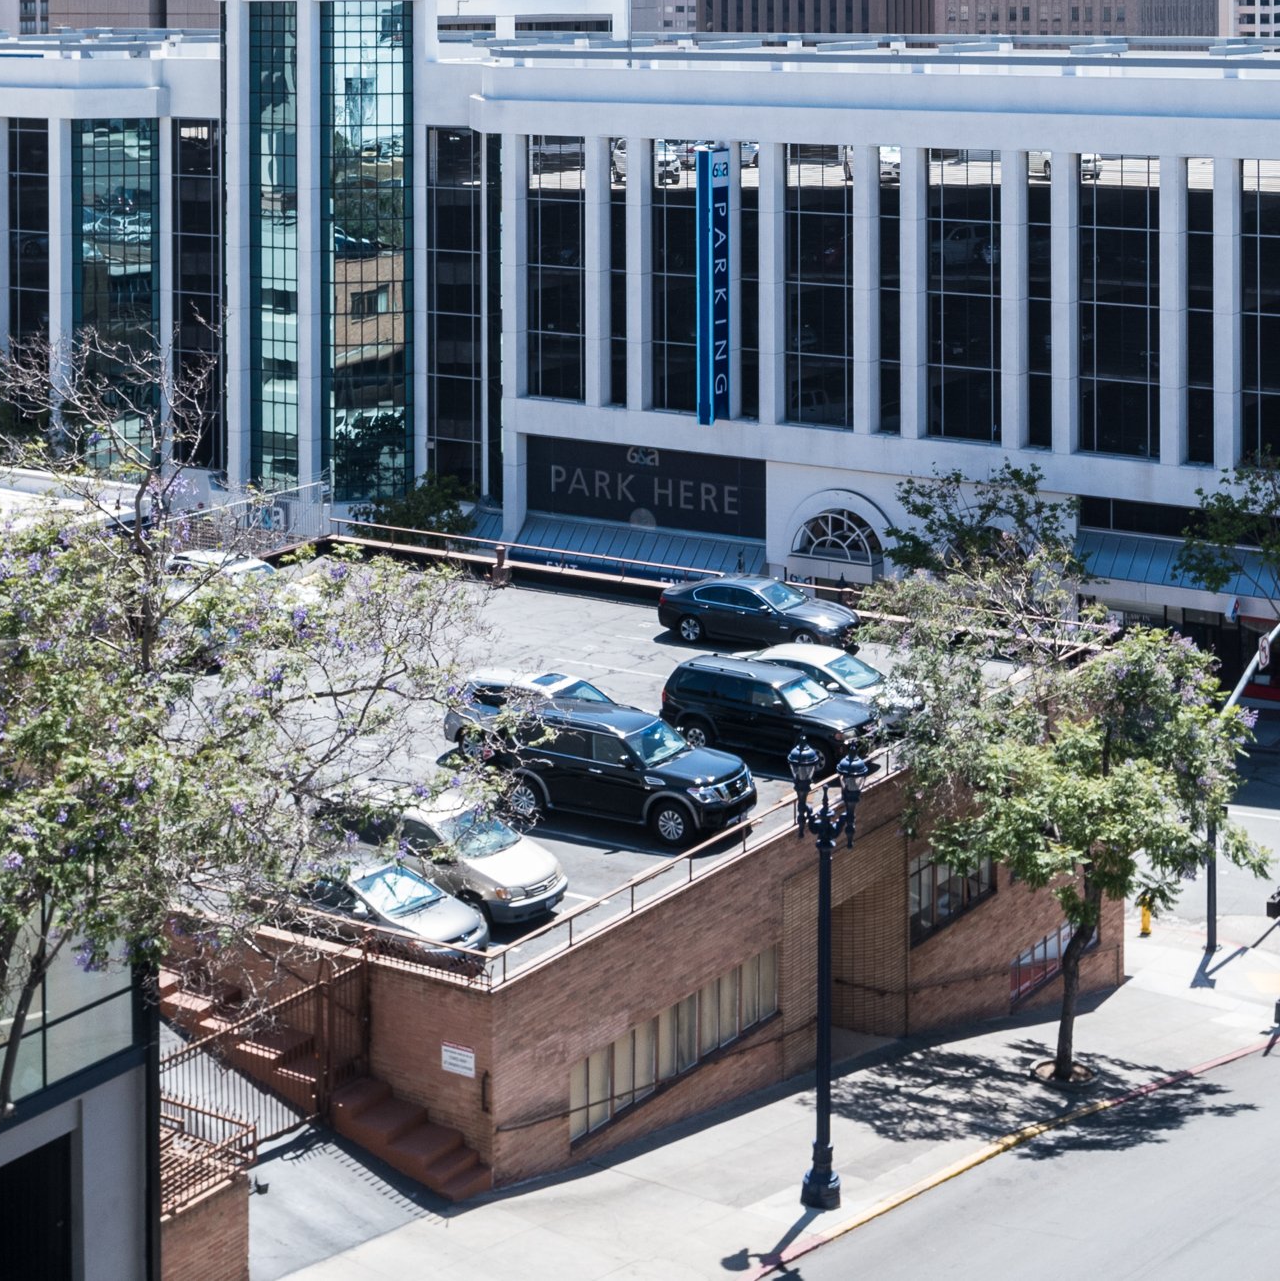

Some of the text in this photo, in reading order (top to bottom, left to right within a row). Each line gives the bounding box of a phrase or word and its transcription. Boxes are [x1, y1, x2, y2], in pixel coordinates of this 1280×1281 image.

[714, 202, 728, 395] PARKING
[551, 465, 739, 515] PARK HERE
